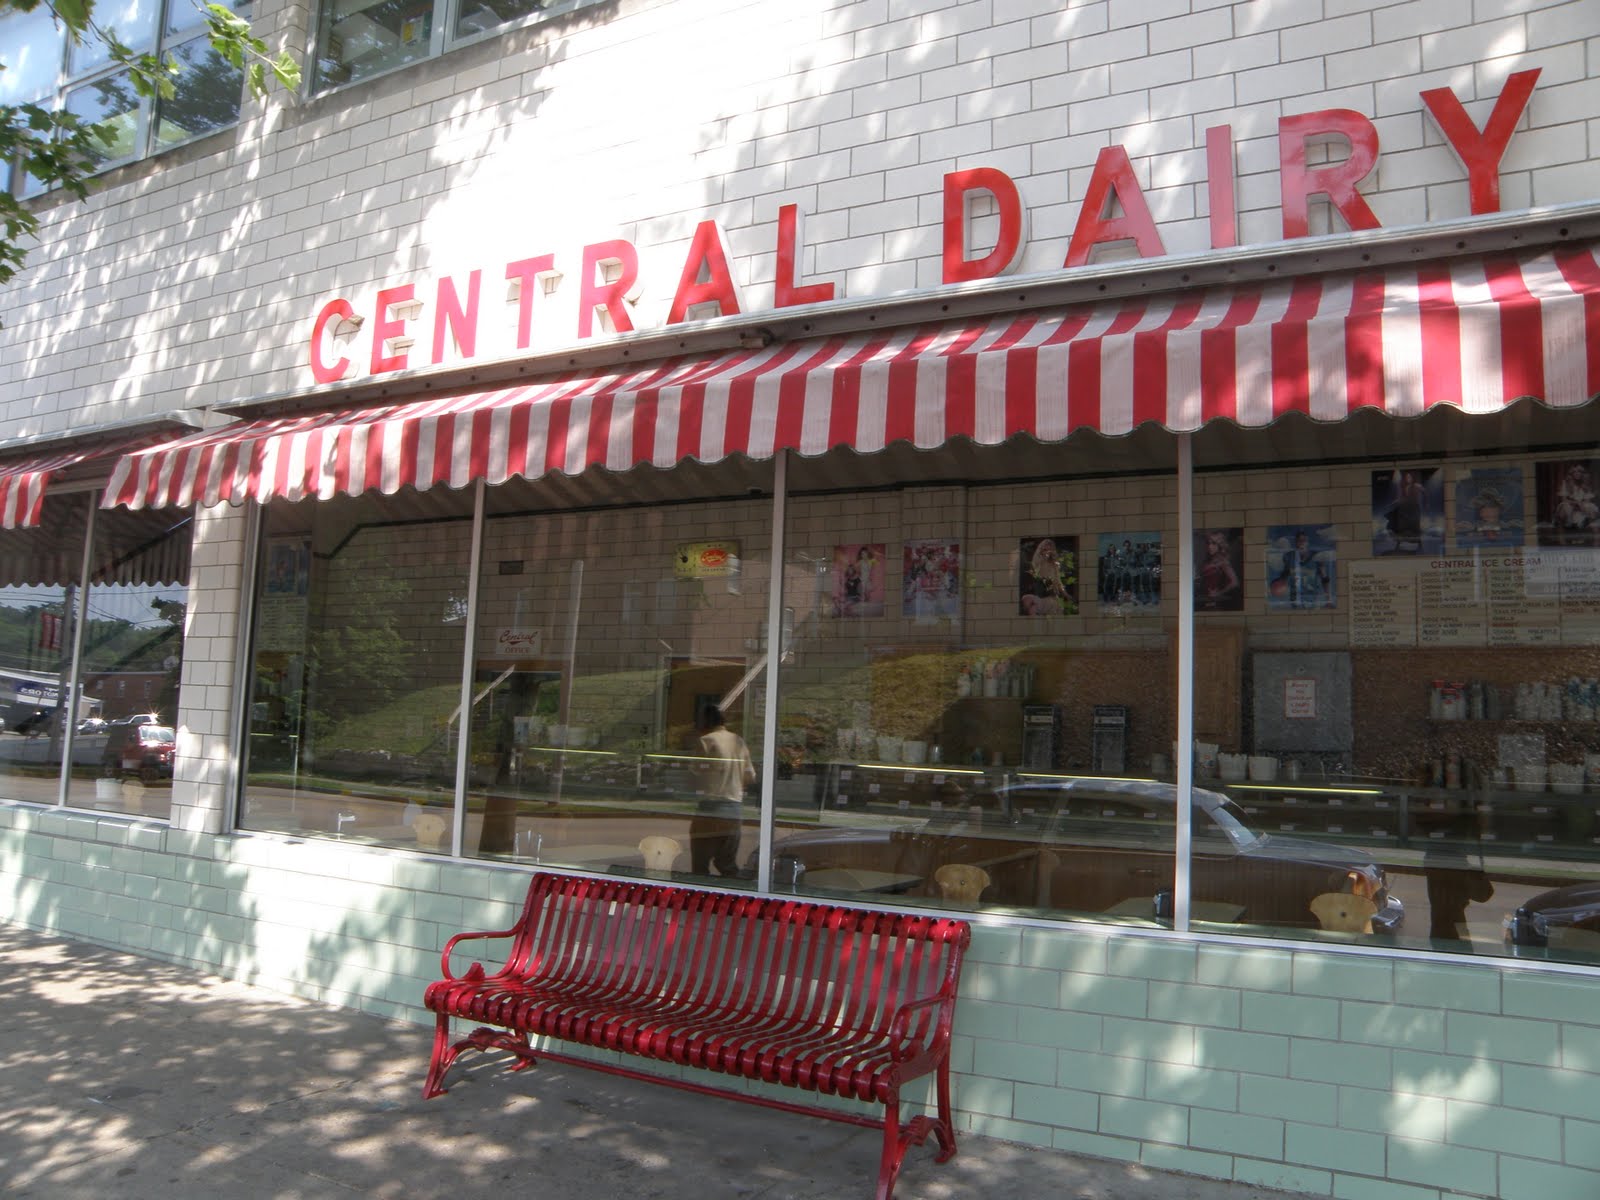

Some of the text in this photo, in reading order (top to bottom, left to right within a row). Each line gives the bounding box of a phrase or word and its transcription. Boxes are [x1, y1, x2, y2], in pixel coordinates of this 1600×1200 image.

[310, 67, 1543, 384] CENTRAL DAIRY
[1431, 558, 1541, 569] CENTRAL ICE CREAM
[499, 629, 538, 645] Central
